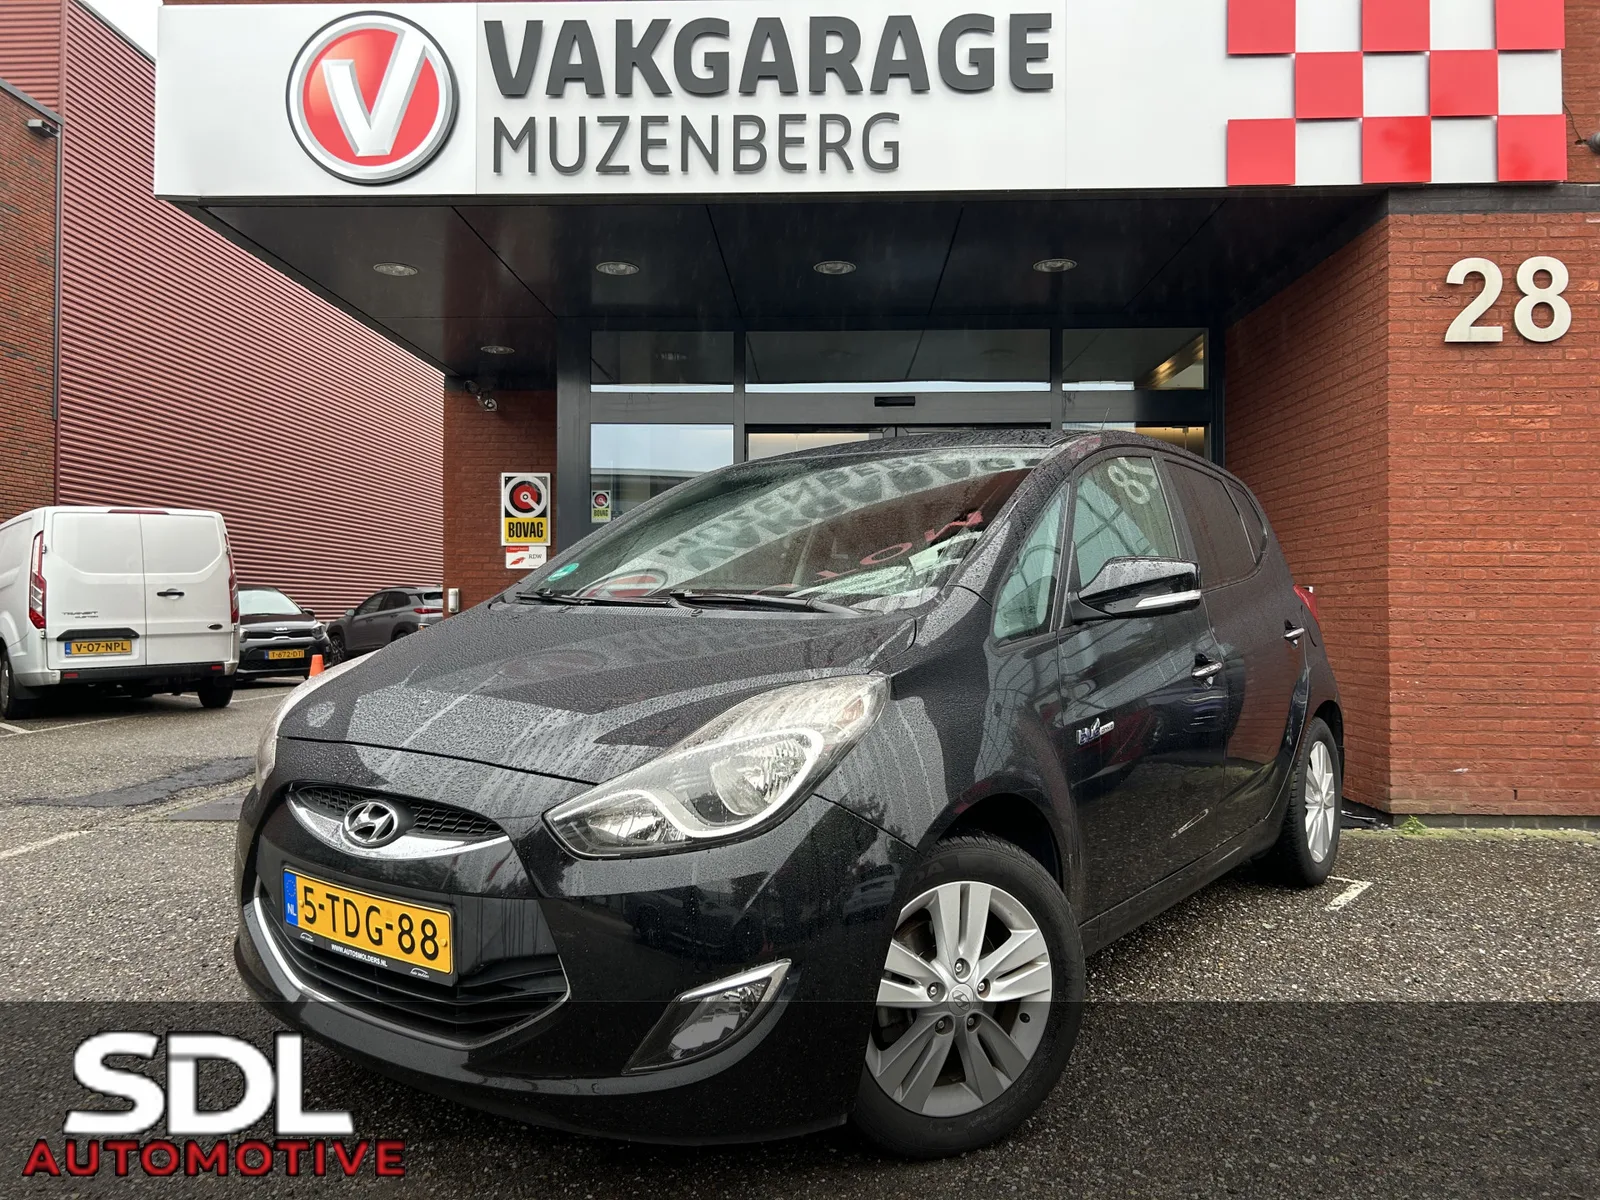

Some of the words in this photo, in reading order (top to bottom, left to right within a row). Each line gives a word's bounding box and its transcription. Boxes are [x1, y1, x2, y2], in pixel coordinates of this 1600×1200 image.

[483, 13, 1054, 97] VAKGARAGE
[321, 30, 426, 157] V
[493, 112, 901, 175] MUZENBERG
[1444, 256, 1572, 342] 28
[508, 521, 543, 538] BOVAG
[75, 642, 127, 652] V-07-NPL
[287, 902, 297, 917] NL
[303, 885, 439, 961] 5-TDG-88
